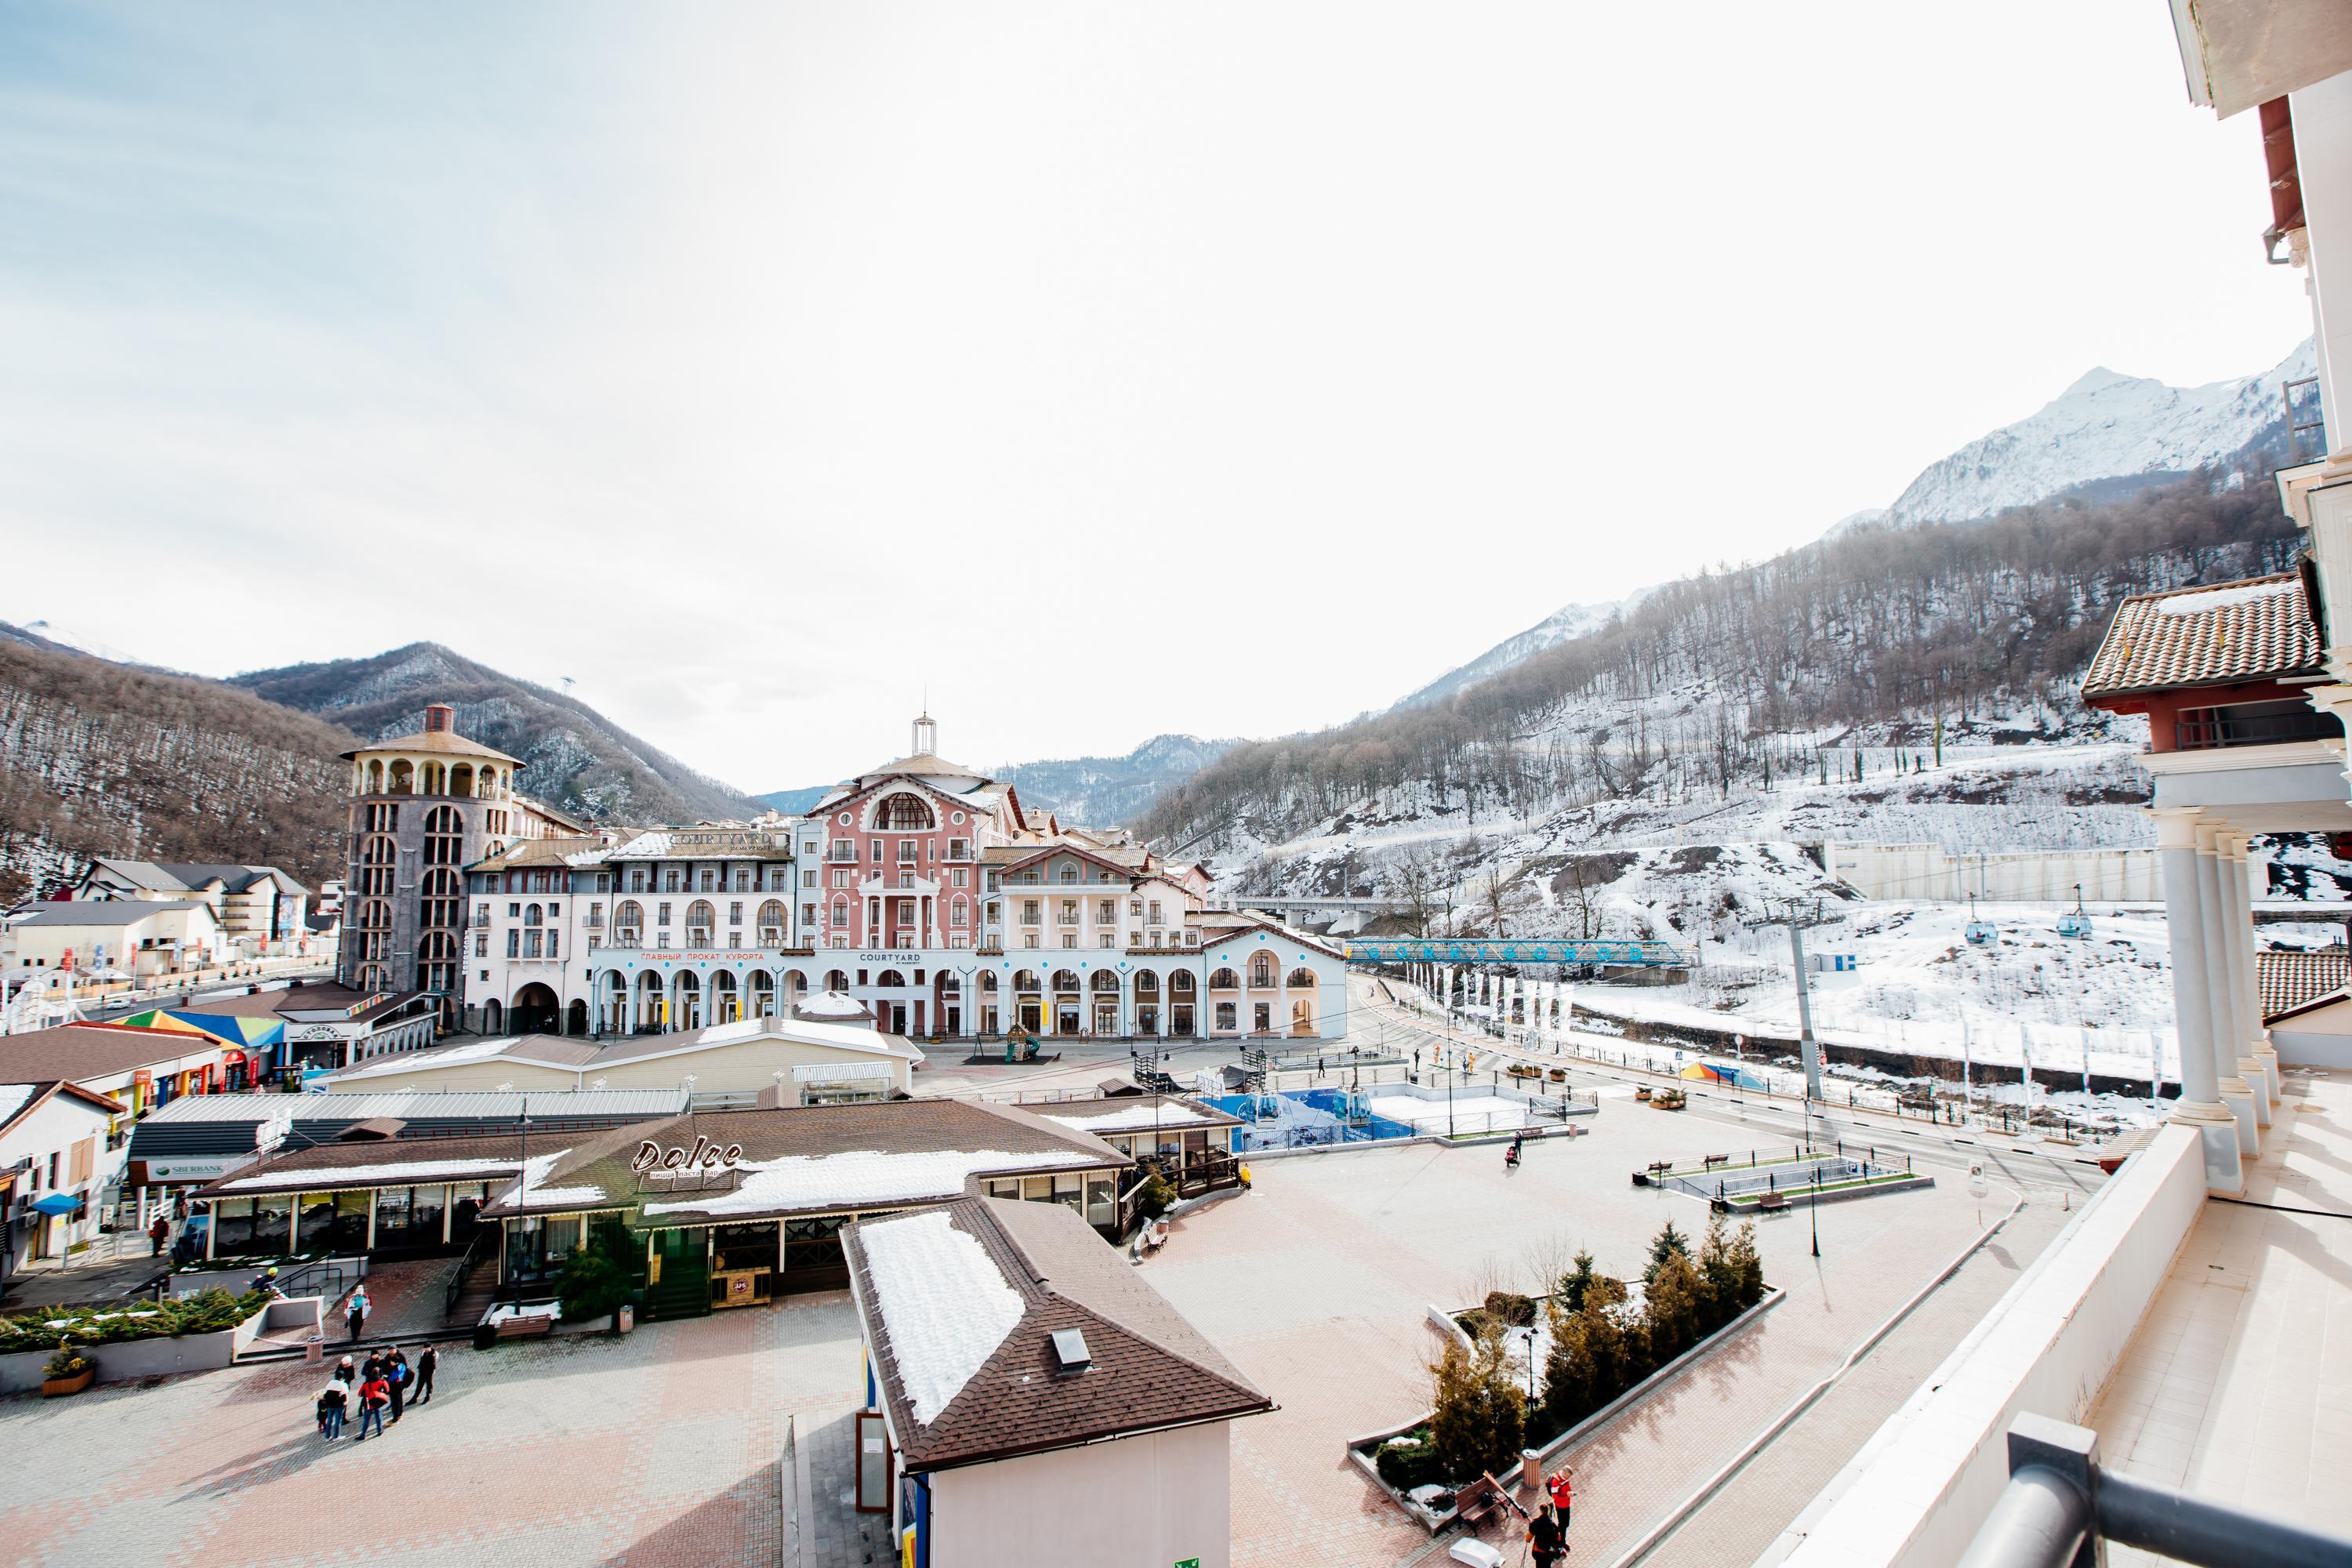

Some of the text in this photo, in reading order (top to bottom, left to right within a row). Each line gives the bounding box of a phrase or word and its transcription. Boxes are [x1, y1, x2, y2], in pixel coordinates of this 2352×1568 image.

[303, 1026, 339, 1039] СТОЛОВАЯ
[632, 1136, 742, 1171] Dolce
[704, 1169, 719, 1178] бар
